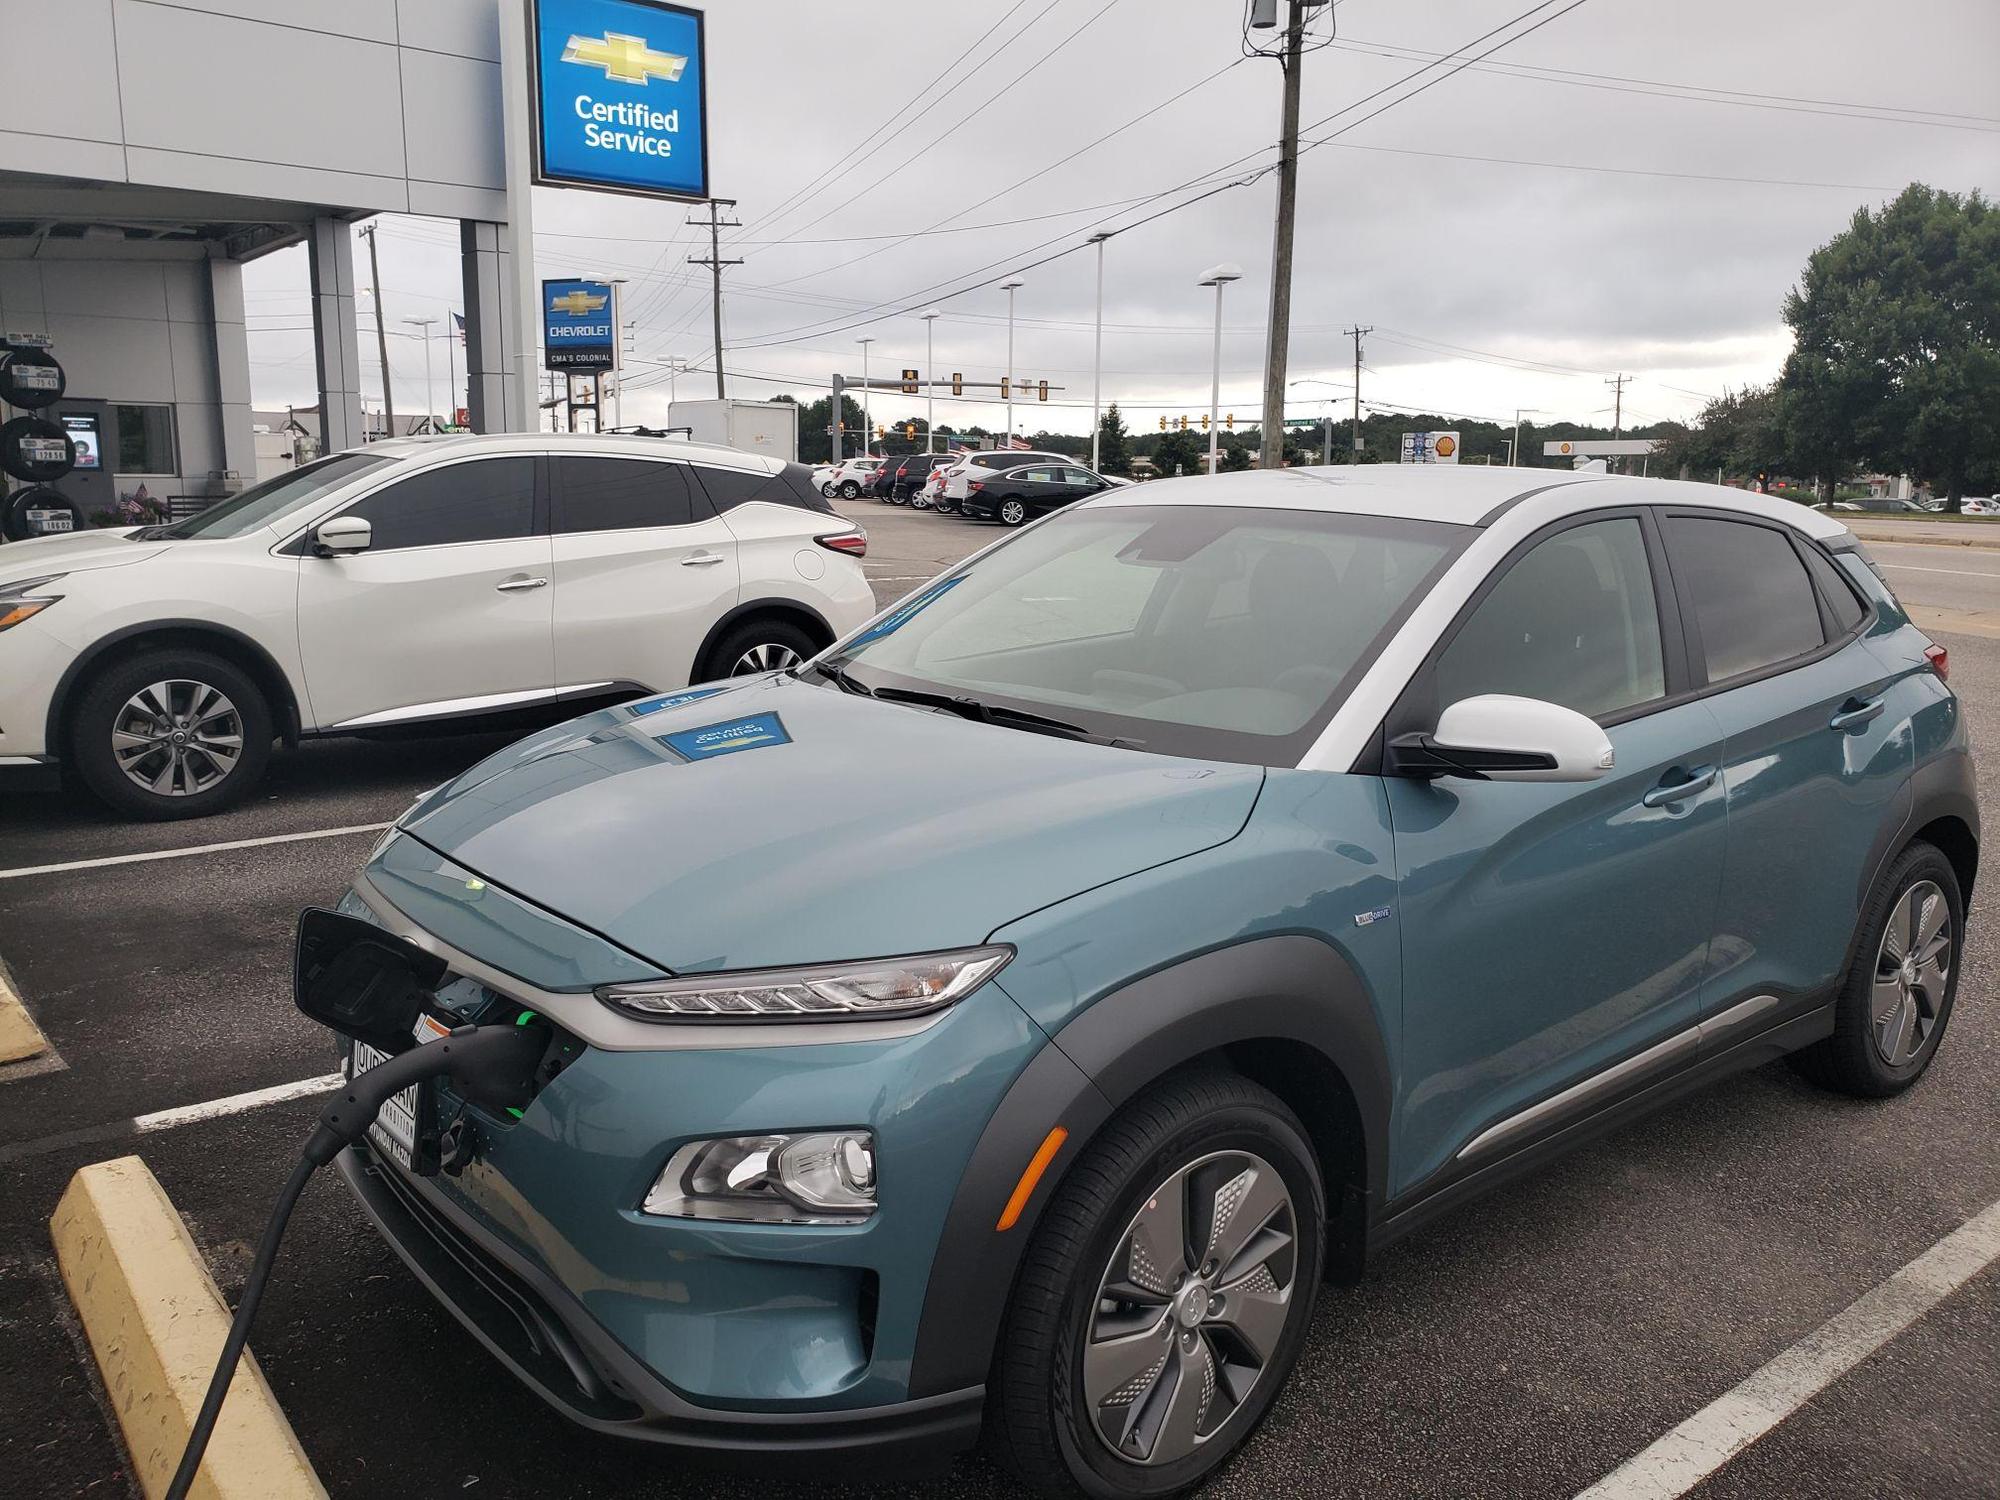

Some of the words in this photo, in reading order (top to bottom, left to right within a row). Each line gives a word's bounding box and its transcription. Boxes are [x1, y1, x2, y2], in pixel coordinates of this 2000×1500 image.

[574, 94, 679, 133] Certified
[584, 122, 672, 157] Service
[549, 325, 610, 337] CHEVROLET
[551, 354, 574, 362] CMA'S
[575, 354, 611, 362] COLONIAL
[392, 1140, 412, 1171] MAZDA
